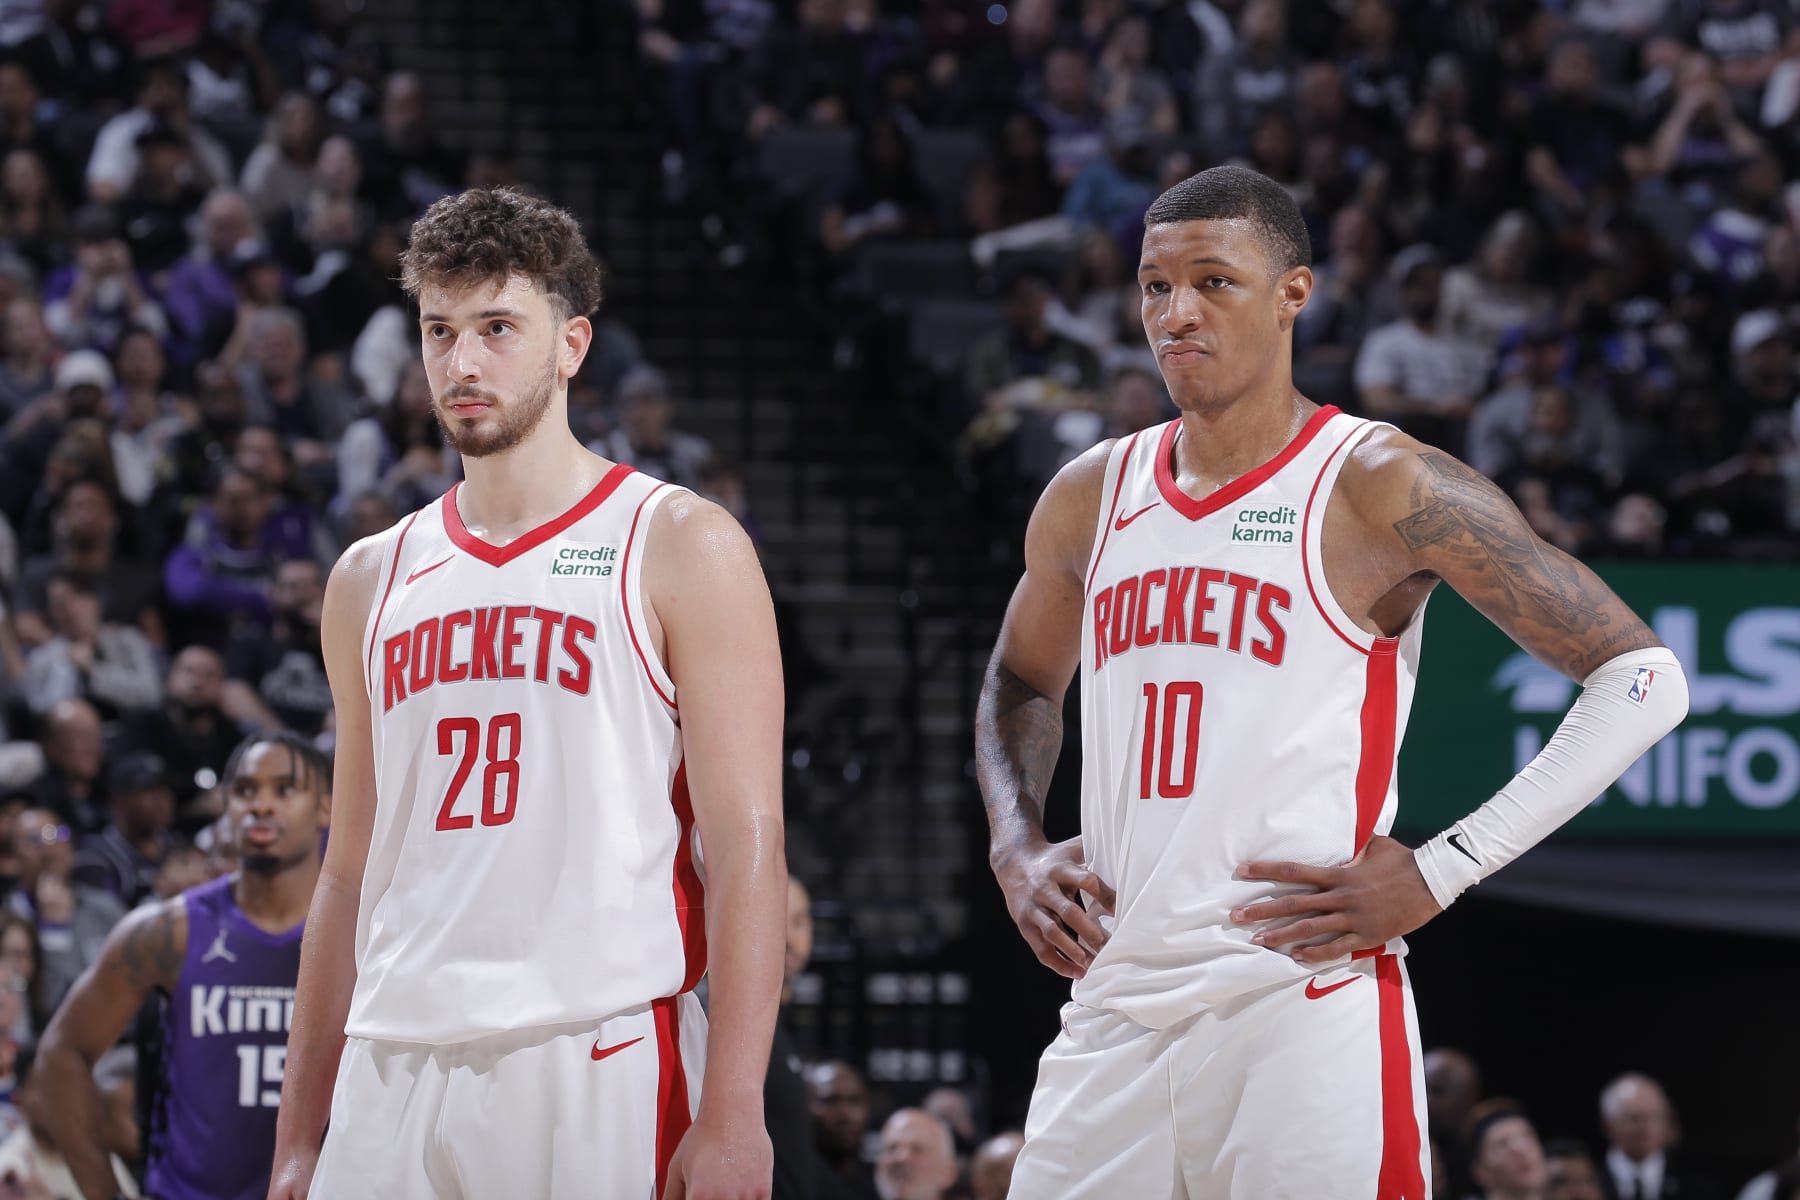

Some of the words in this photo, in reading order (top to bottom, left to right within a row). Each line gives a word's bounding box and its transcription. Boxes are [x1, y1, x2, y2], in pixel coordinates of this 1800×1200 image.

[1231, 523, 1293, 543] karma
[1238, 506, 1297, 525] credit
[551, 558, 612, 576] karma
[559, 546, 617, 561] credit
[1093, 566, 1292, 674] ROCKETS
[383, 604, 597, 715] ROCKETS
[436, 712, 522, 832] 28
[1140, 681, 1204, 799] 10
